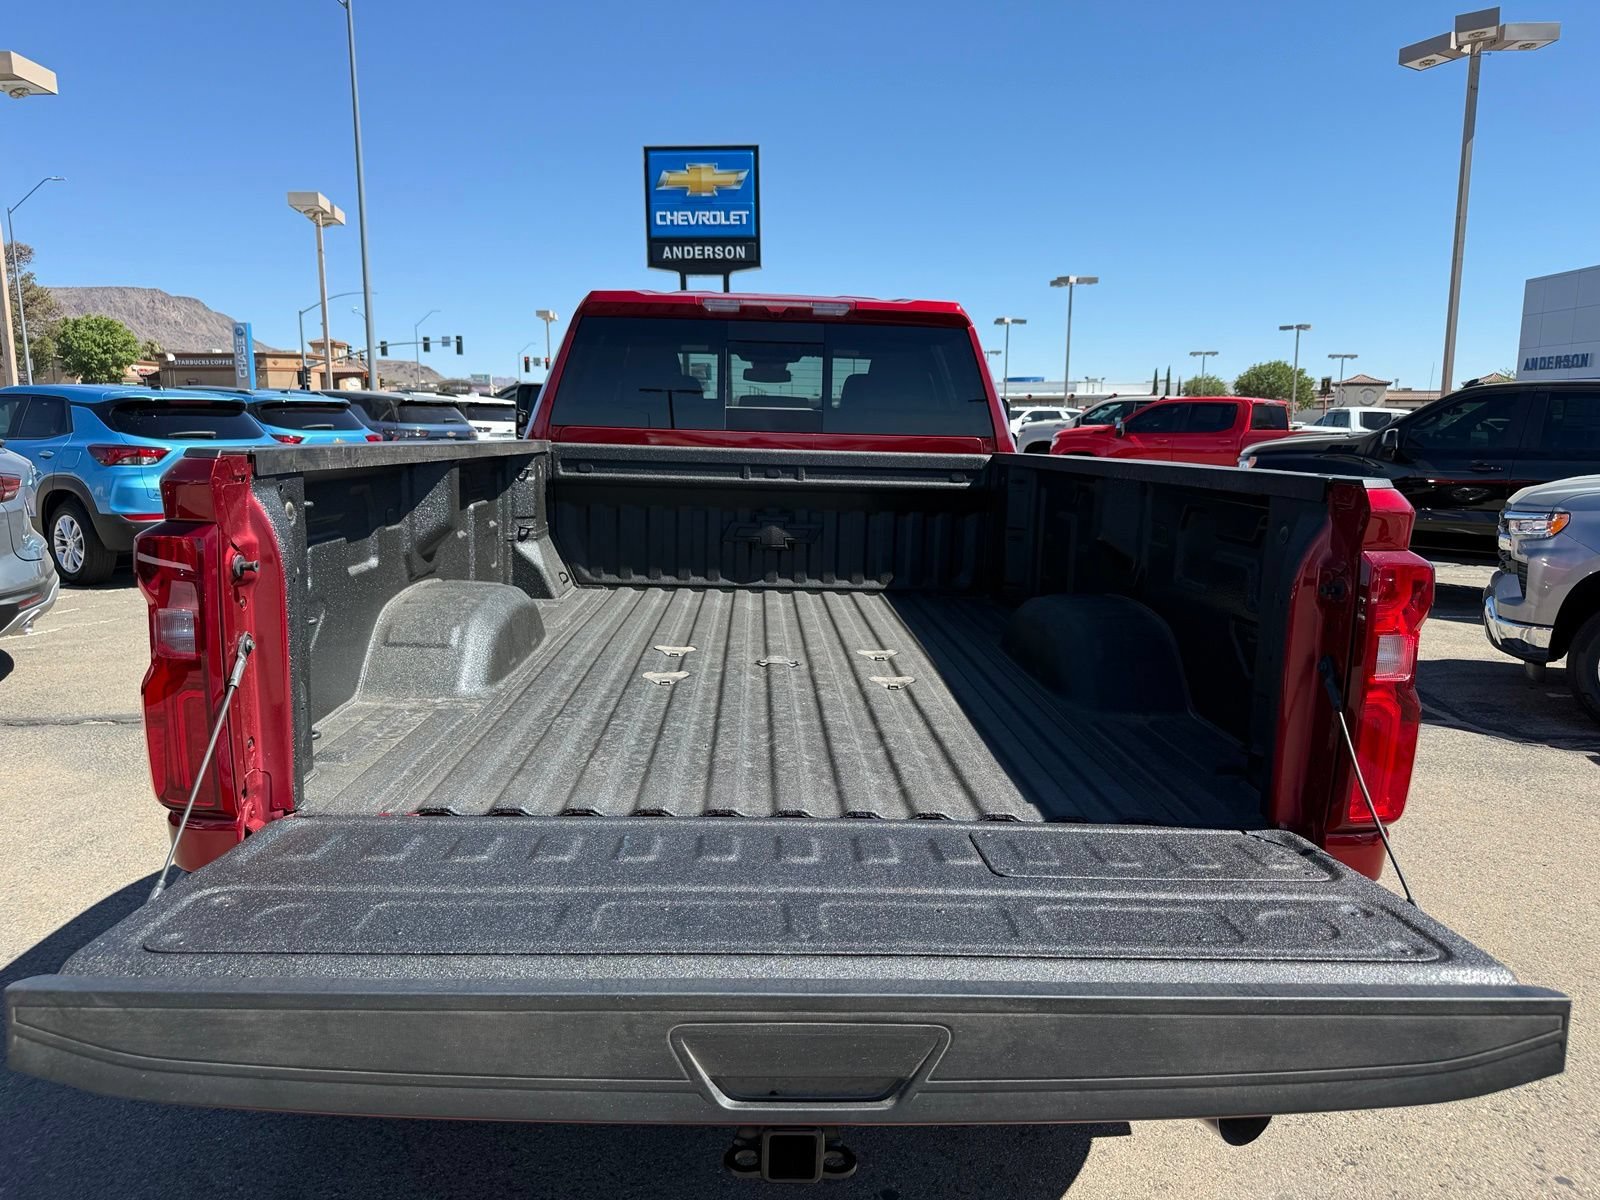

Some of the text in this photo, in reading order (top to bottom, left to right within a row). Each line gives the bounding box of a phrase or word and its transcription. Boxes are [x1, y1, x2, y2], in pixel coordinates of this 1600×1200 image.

[656, 210, 749, 225] CHEVROLET
[662, 245, 746, 259] ANDERSON
[236, 337, 248, 378] CHASE
[1523, 352, 1590, 371] ANDERSON
